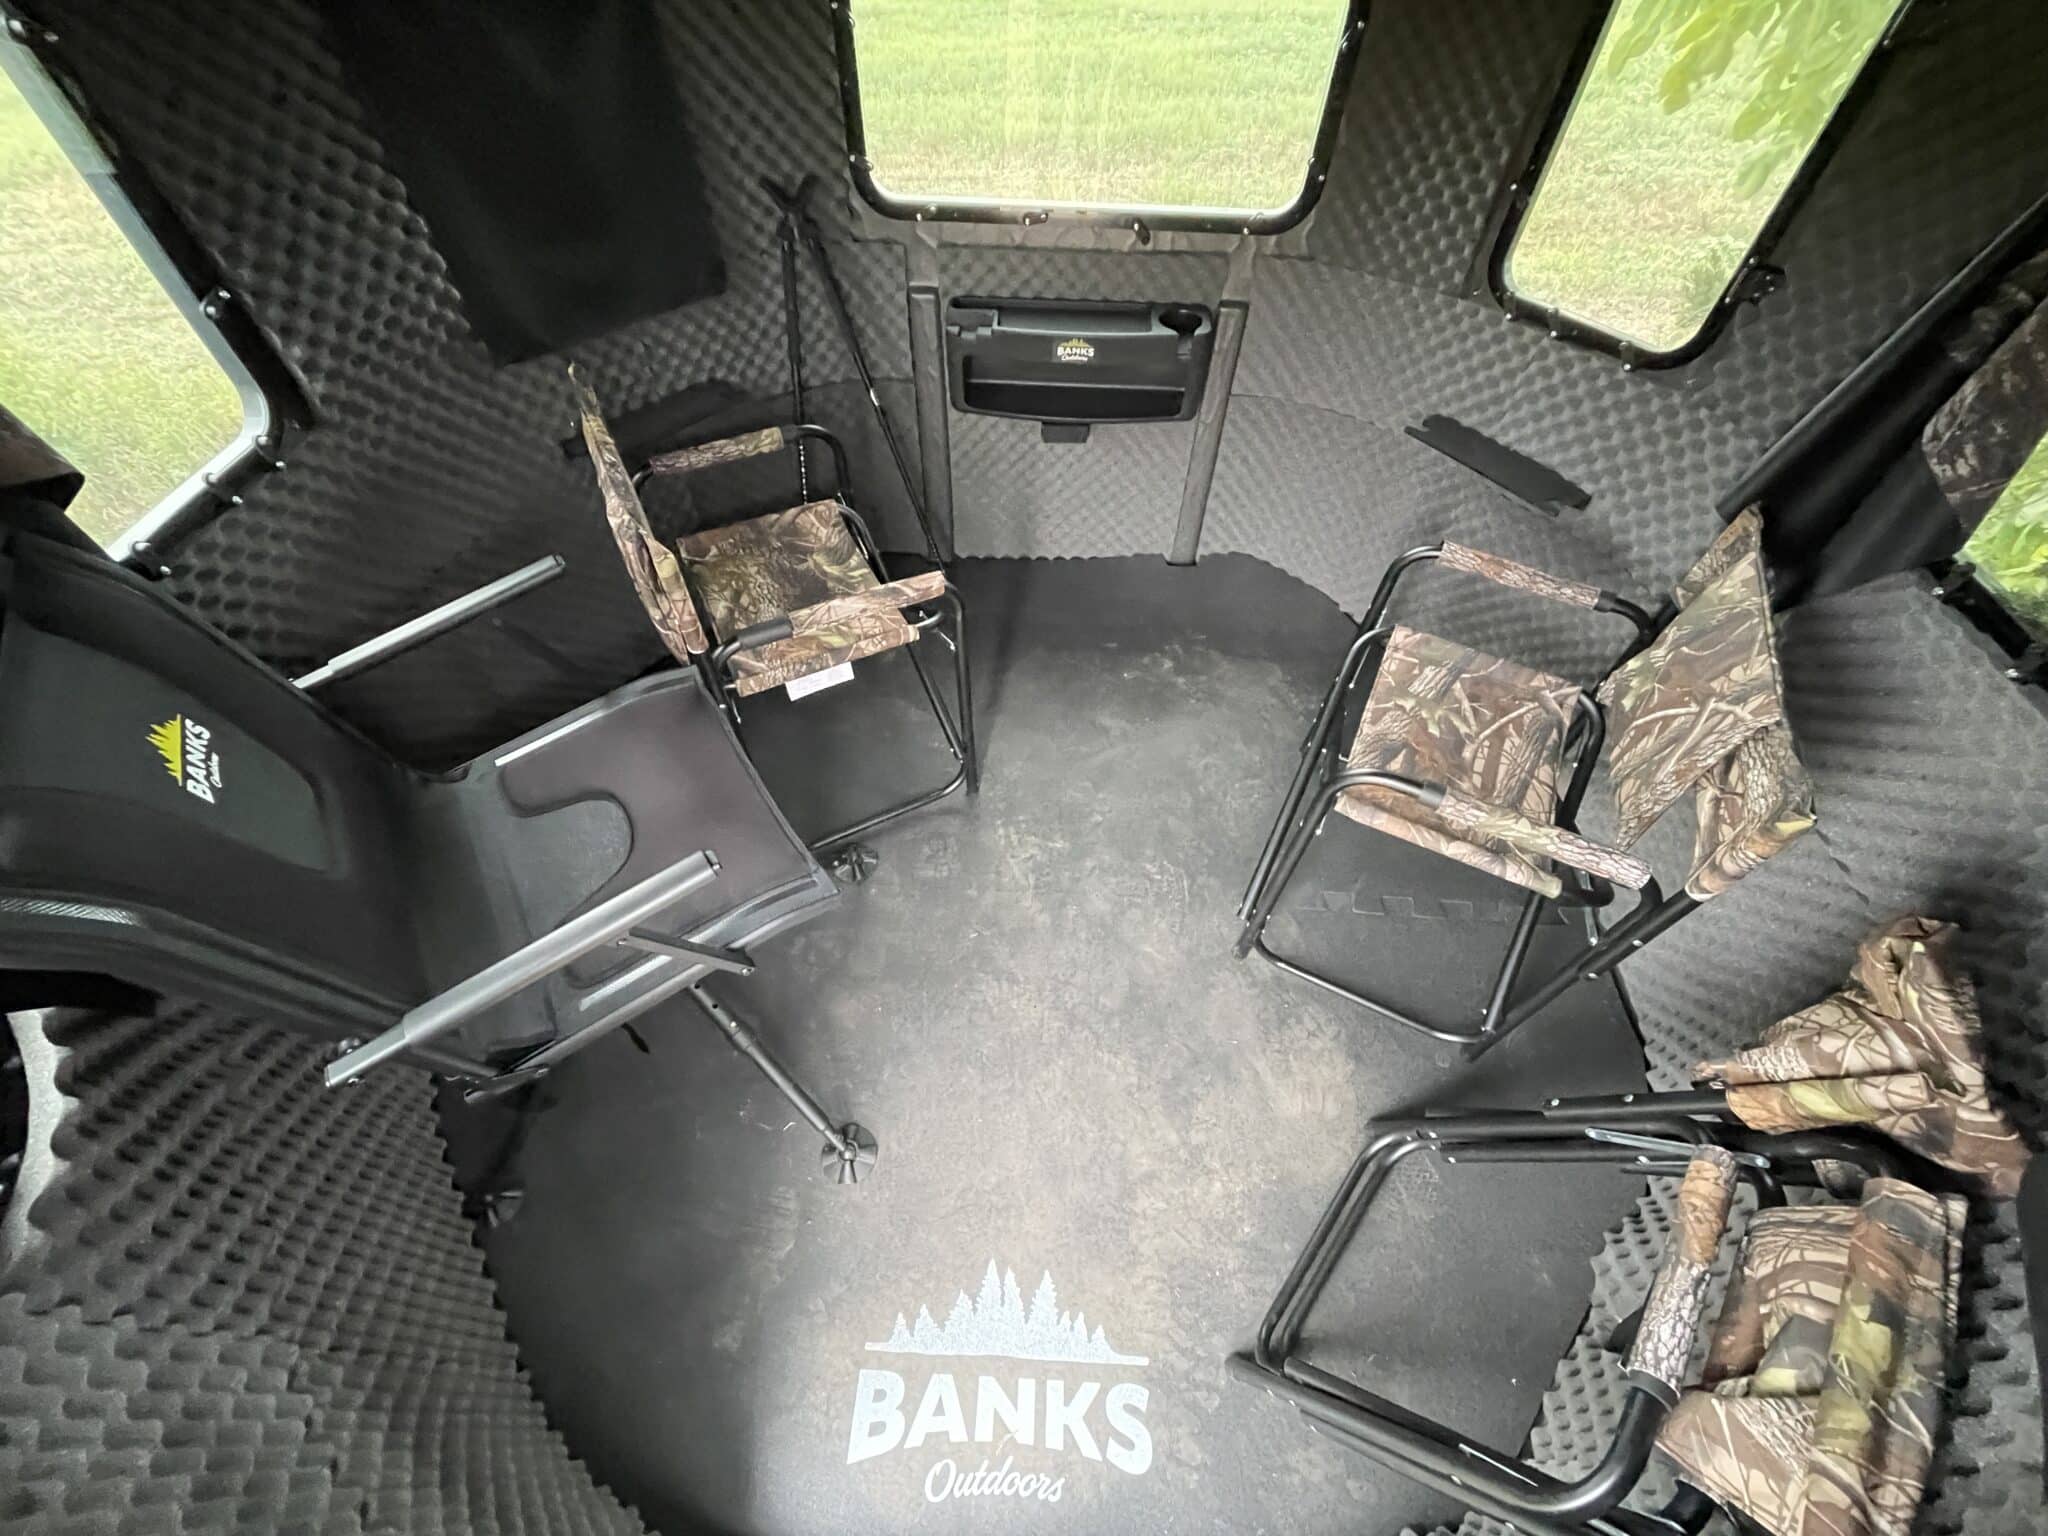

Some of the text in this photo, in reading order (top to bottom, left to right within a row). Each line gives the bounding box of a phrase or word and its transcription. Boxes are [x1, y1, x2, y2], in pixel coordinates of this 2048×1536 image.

[1057, 346, 1095, 357] BANKS
[185, 718, 215, 804] BANKS
[847, 1368, 1153, 1475] BANKS
[924, 1455, 1066, 1502] Outdoors
